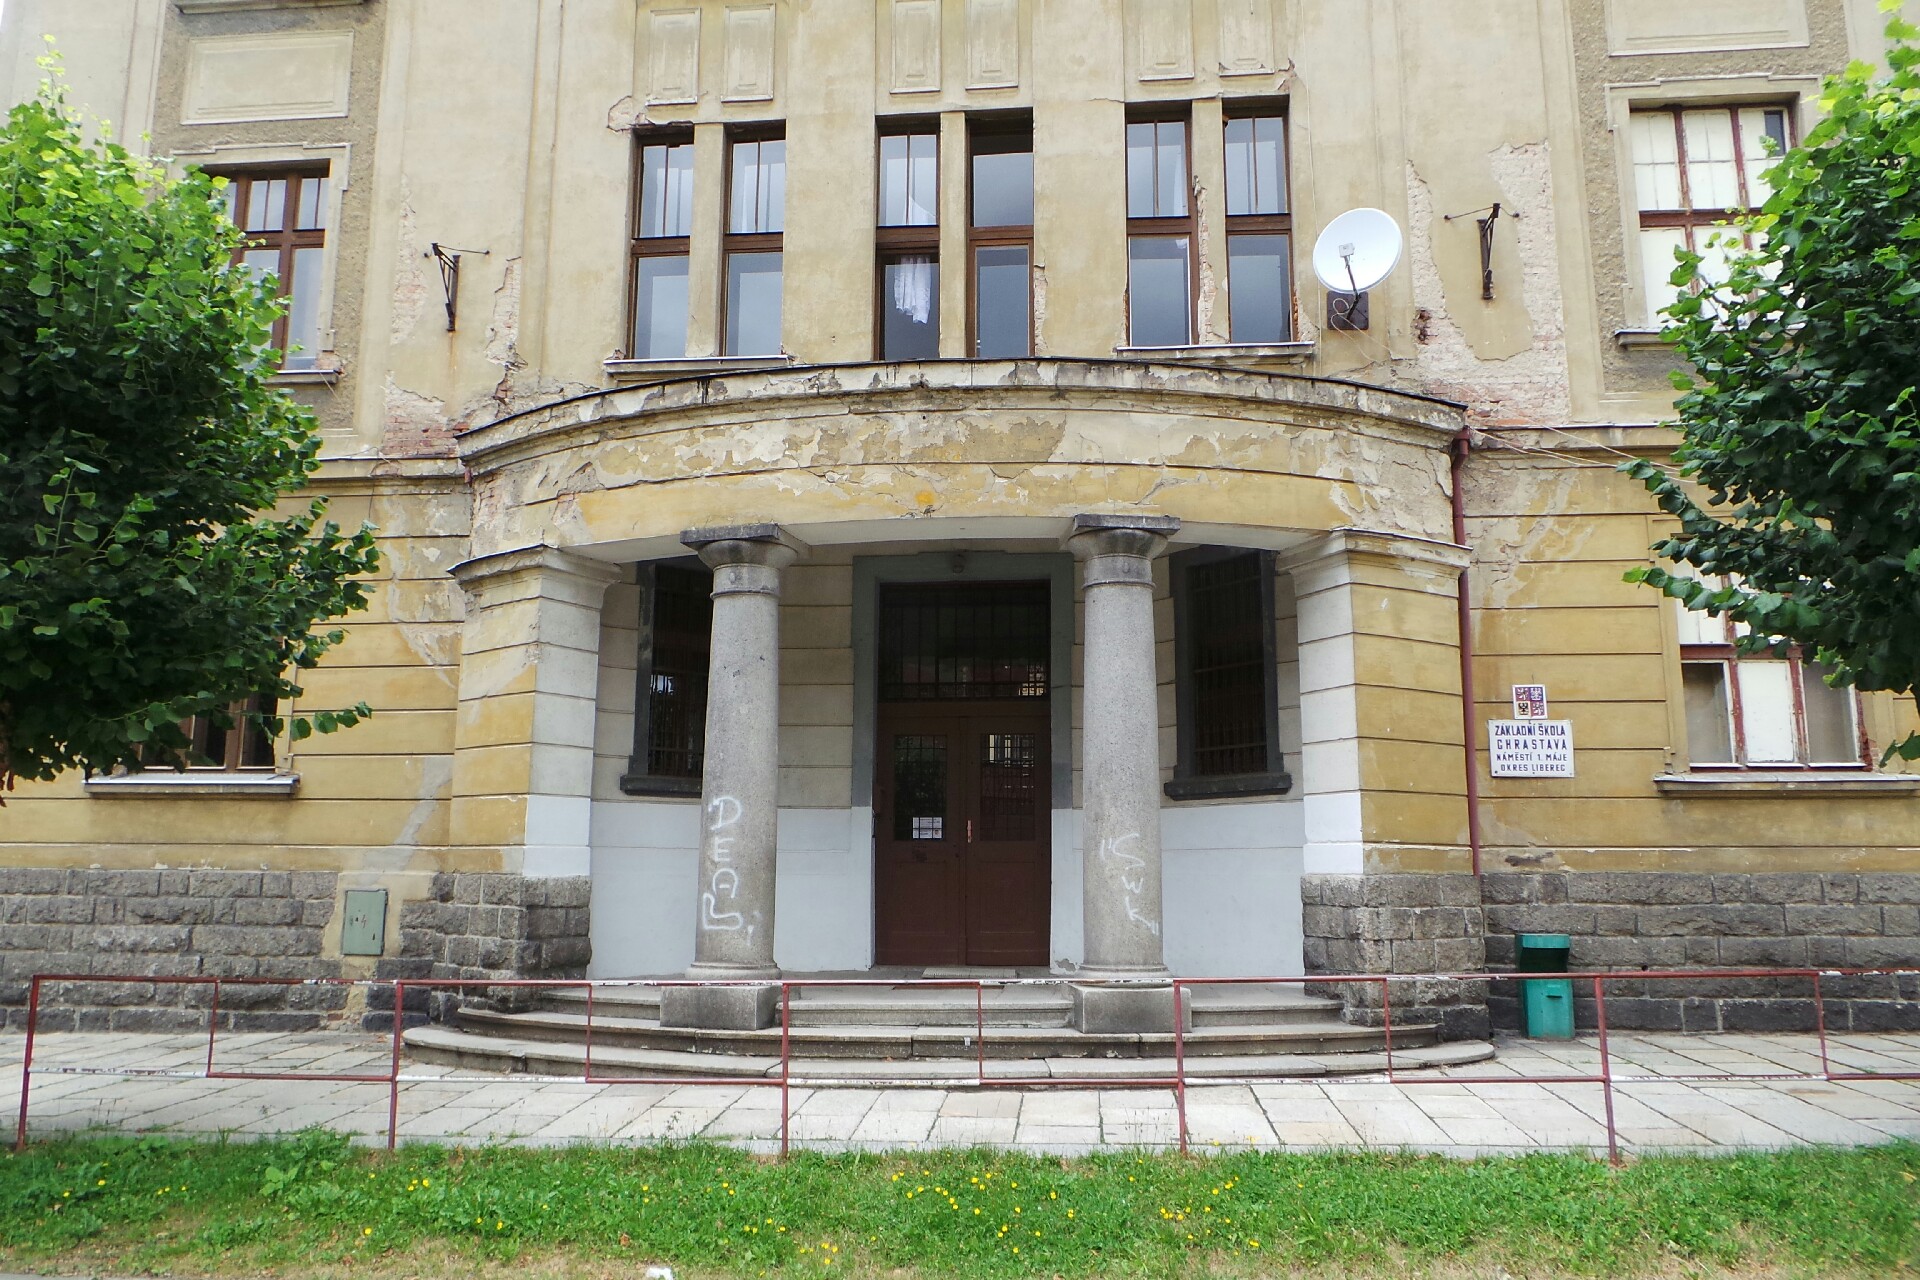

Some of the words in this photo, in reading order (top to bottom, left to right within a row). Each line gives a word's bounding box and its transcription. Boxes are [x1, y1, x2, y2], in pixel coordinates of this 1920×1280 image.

[1495, 723, 1536, 736] ZÁKLADNÍ
[1538, 723, 1566, 736] ŠKOLA
[1497, 739, 1567, 750] CHRASTAVA
[1496, 752, 1533, 761] NÁMĚSTÍ
[1545, 752, 1567, 761] MÁJE
[1500, 764, 1529, 772] OKRES
[1531, 763, 1566, 772] LIBEREC
